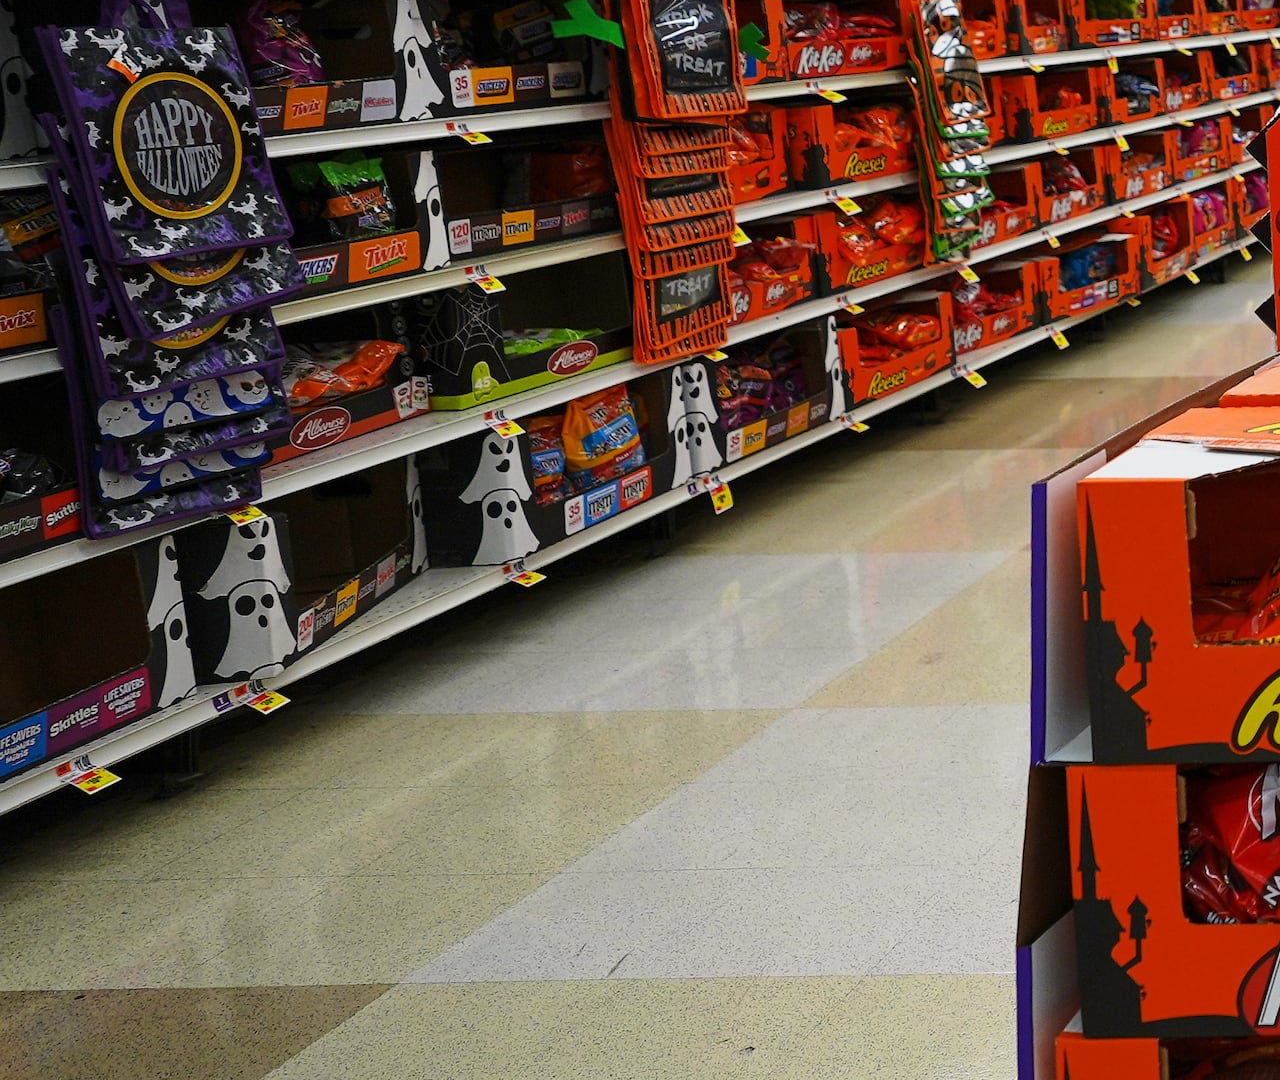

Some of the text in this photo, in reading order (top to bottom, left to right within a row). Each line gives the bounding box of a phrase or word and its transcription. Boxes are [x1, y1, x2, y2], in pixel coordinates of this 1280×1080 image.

[672, 53, 726, 77] TREAT
[797, 44, 843, 74] KitKat
[454, 78, 468, 91] 35
[291, 100, 321, 118] Twix
[134, 97, 215, 149] HAPPY
[135, 143, 223, 197] HALLOWEEN
[844, 152, 887, 177] Reese's
[365, 239, 408, 268] Twix
[549, 347, 595, 370] Albanese
[474, 376, 492, 391] 45
[867, 368, 907, 397] Reese's
[297, 420, 347, 444] Albanese
[117, 678, 144, 696] SAVERS
[50, 703, 99, 737] Skittles
